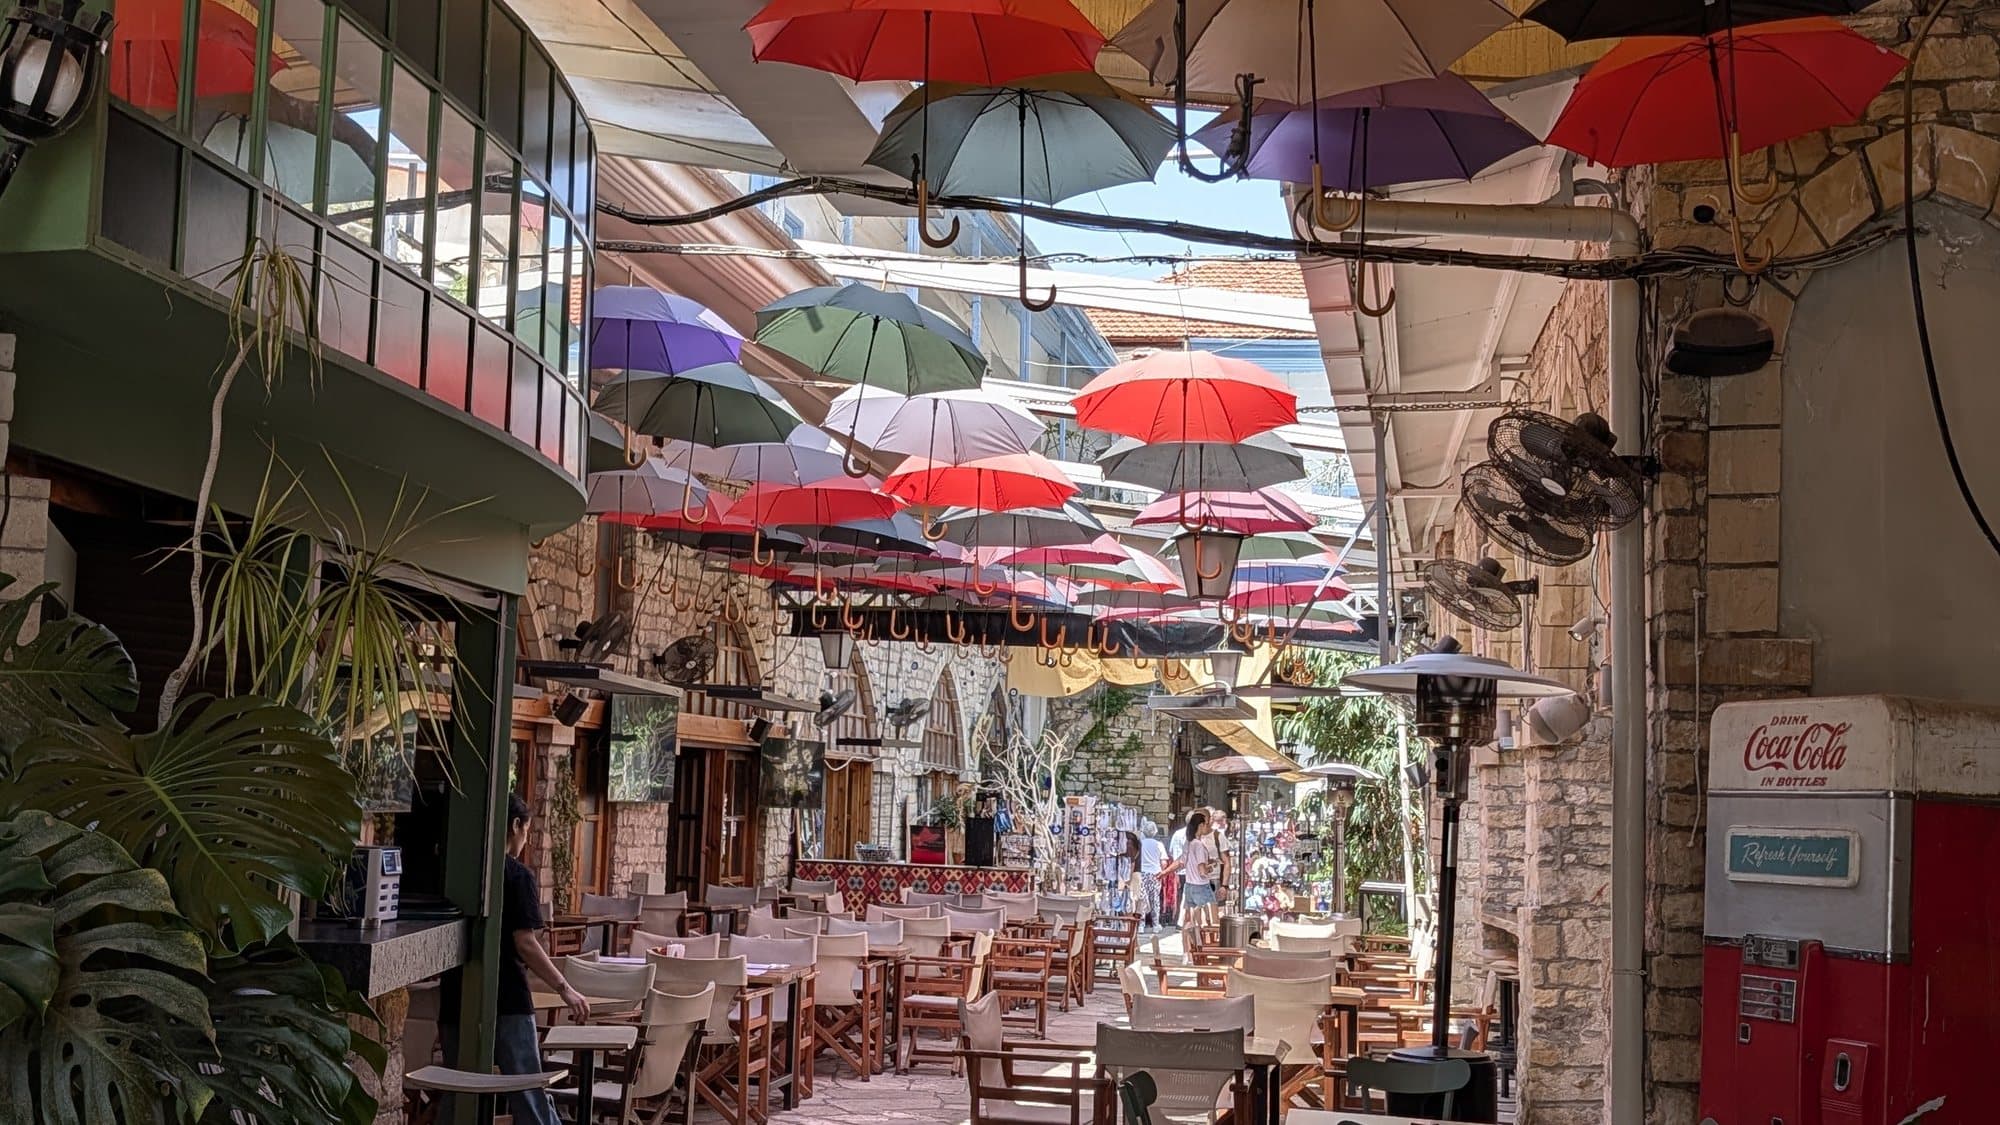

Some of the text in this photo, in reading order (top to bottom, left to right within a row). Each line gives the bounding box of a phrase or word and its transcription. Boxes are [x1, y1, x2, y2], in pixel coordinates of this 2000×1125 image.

[1770, 715, 1808, 726] DRINK
[1744, 721, 1853, 771] Coca-Cola
[1760, 776, 1828, 787] IN BOTTLES
[1741, 842, 1838, 871] Refresh Yourself
